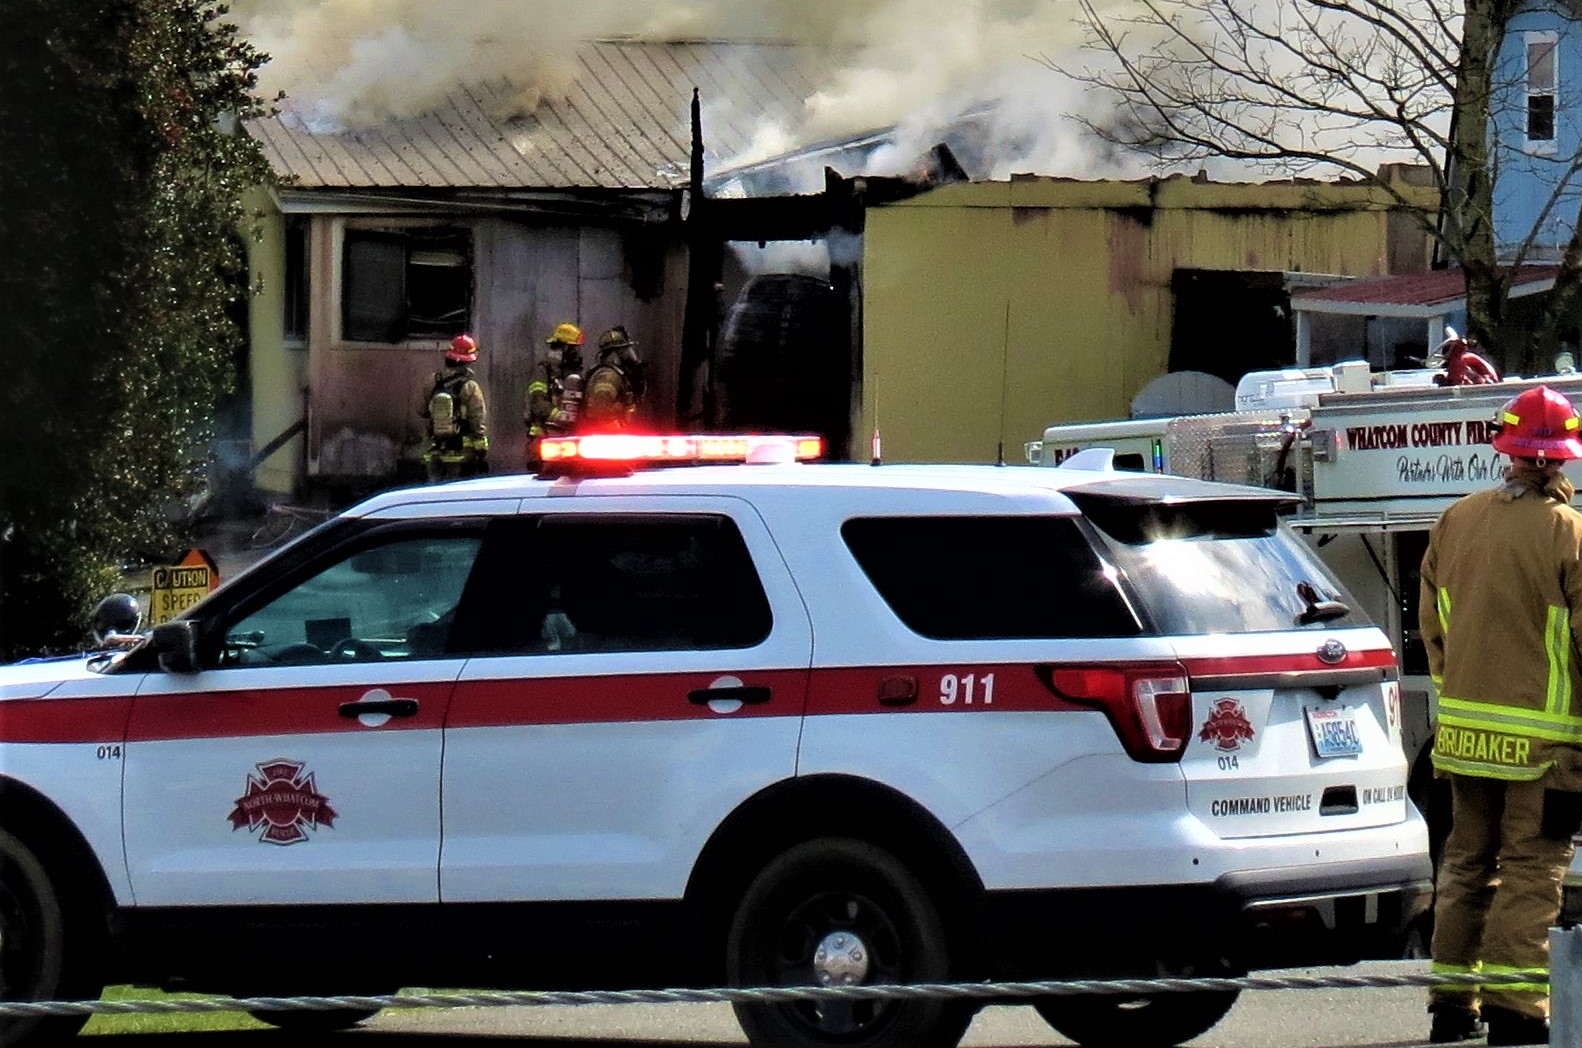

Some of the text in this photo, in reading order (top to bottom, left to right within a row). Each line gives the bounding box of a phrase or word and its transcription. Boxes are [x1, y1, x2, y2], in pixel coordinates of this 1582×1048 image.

[1346, 423, 1409, 450] WHATCOM
[1411, 420, 1462, 448] COUNTY
[1436, 454, 1464, 483] With
[940, 673, 994, 705] 911
[96, 745, 121, 760] 014
[1436, 726, 1531, 764] BRUBAKER
[1217, 755, 1239, 771] 014
[243, 795, 272, 810] NORTH
[1212, 798, 1270, 817] COMMAND
[1273, 794, 1312, 812] VEHICLE
